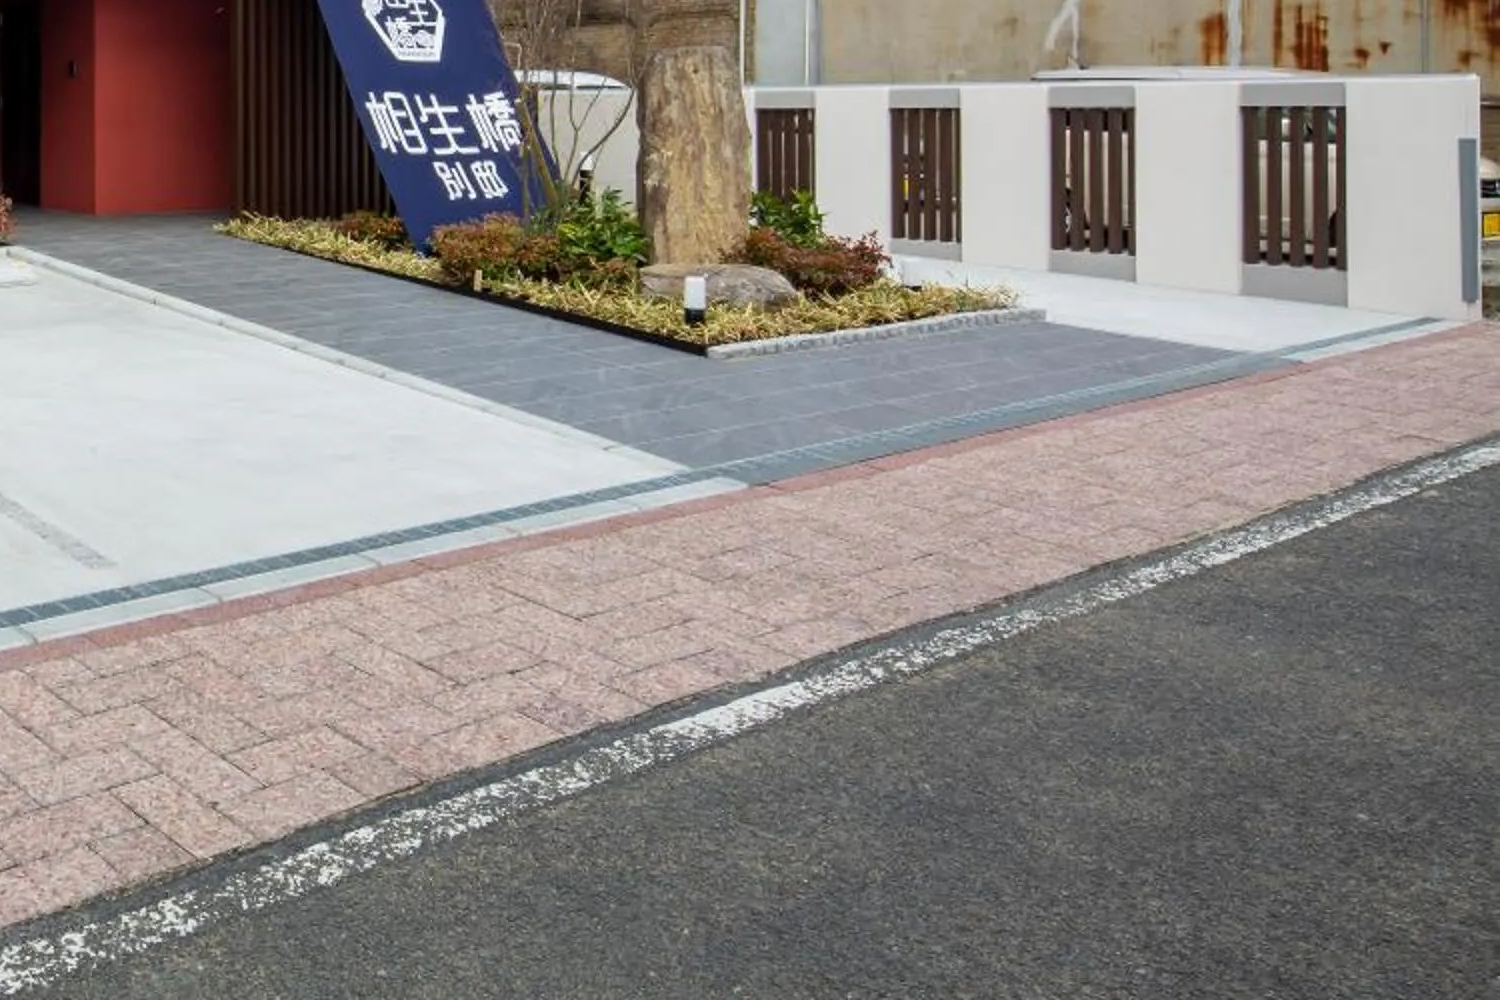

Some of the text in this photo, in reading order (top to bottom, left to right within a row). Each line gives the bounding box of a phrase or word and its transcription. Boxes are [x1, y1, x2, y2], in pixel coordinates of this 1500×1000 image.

[365, 89, 522, 155] 相生橋
[432, 160, 510, 200] 別邸
